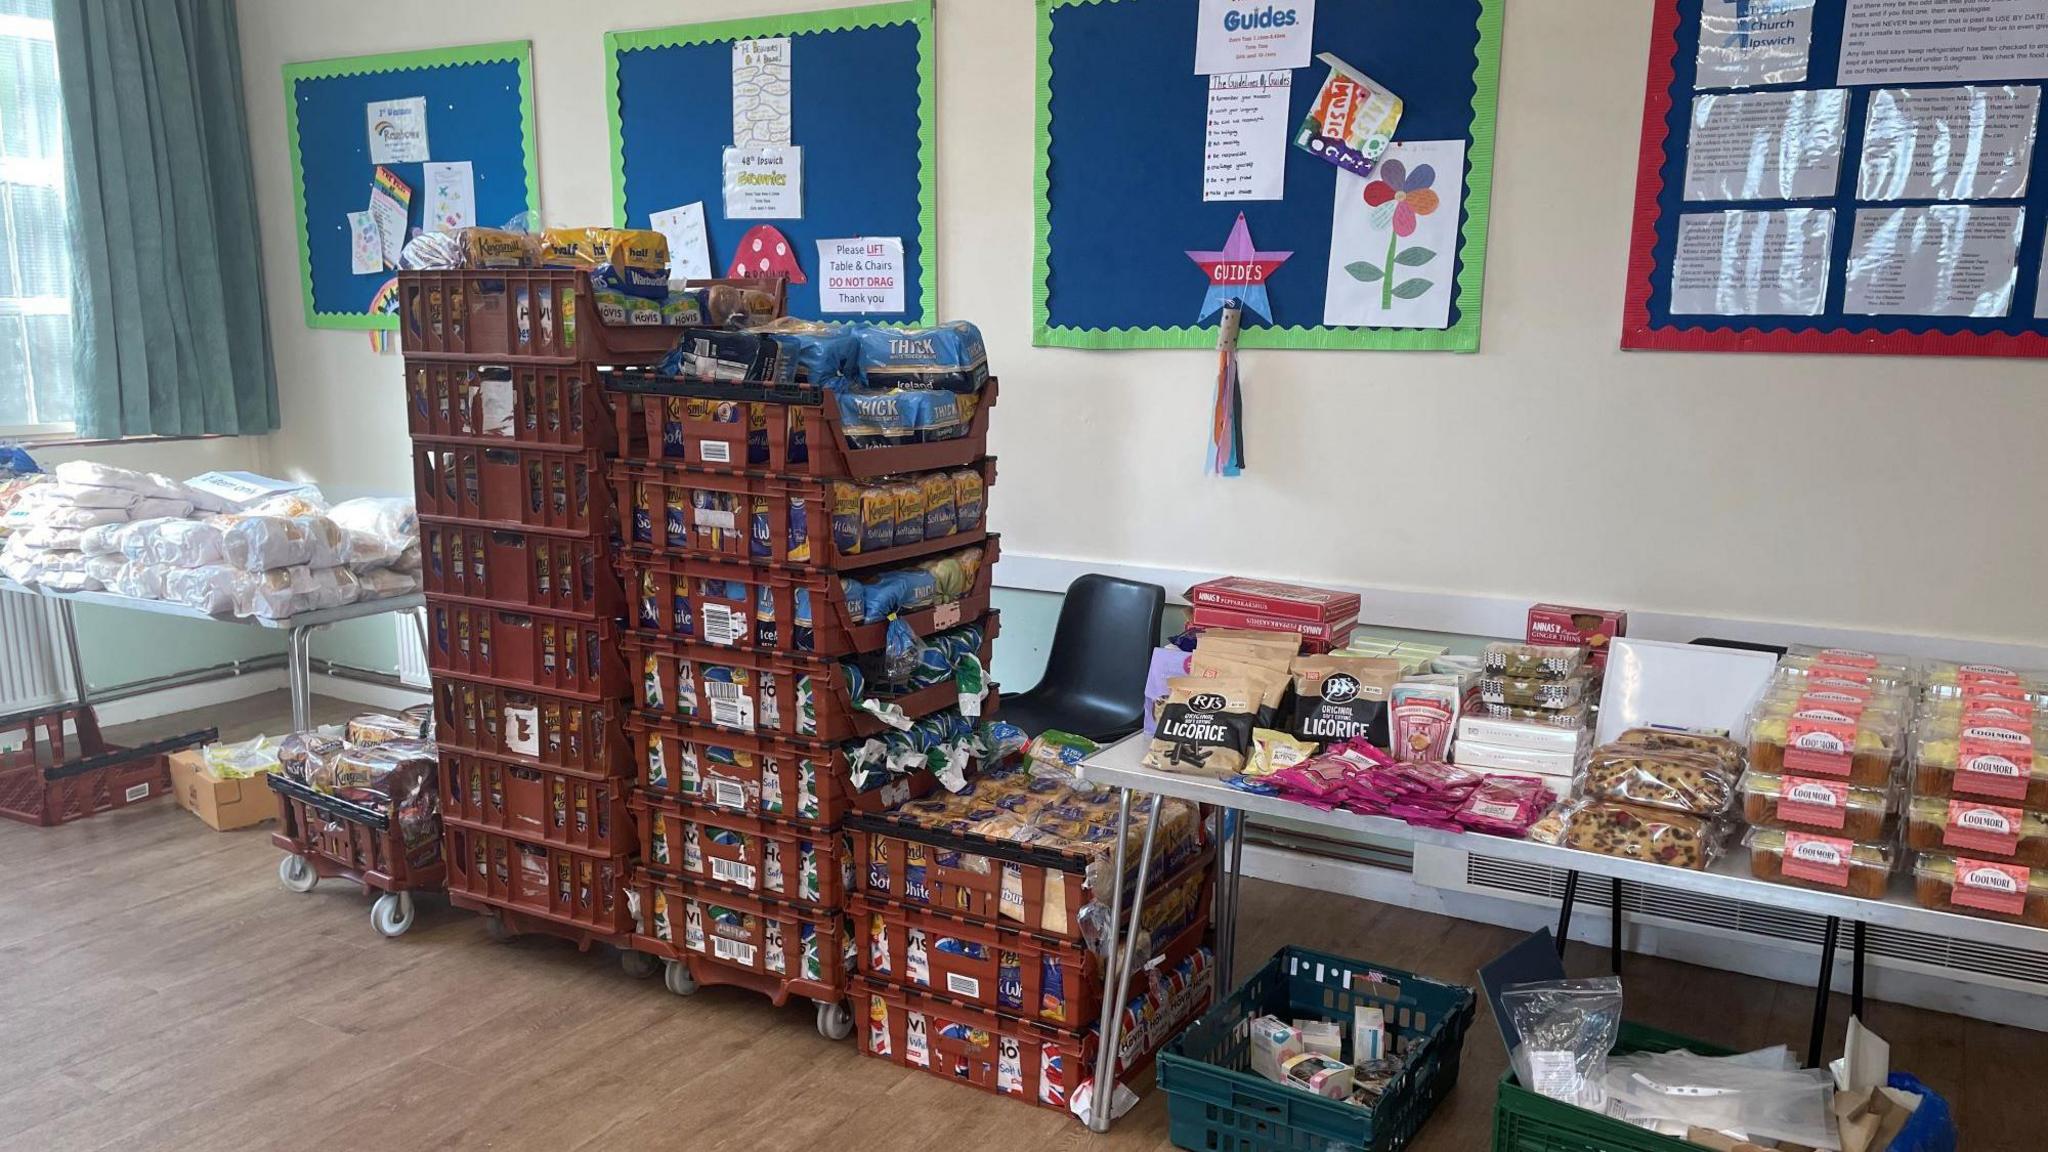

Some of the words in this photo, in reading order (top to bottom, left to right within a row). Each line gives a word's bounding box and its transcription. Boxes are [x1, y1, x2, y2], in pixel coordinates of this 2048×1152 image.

[1224, 5, 1296, 32] Guides
[2025, 13, 2046, 21] DATE
[1751, 20, 1795, 31] Church
[1968, 25, 1987, 33] illegal
[1749, 36, 1795, 50] Ipswich
[1874, 57, 1914, 65] temperature
[1213, 76, 1227, 89] The
[1228, 73, 1259, 88] Guidelines
[1268, 72, 1290, 87] Guides
[1328, 83, 1351, 138] MUSIC
[757, 155, 784, 166] Ipswich
[478, 237, 521, 257] Kingsmill
[629, 248, 648, 257] half
[837, 244, 865, 255] Please
[866, 244, 885, 255] LIFT
[830, 261, 854, 271] Table
[855, 260, 863, 271] &
[864, 260, 893, 271] Chairs
[1214, 264, 1263, 282] GUIDES
[829, 277, 843, 287] DO
[845, 277, 865, 287] NOT
[867, 276, 894, 287] DRAG
[838, 293, 866, 303] Thank
[867, 295, 885, 305] you
[888, 339, 936, 354] THICK
[897, 381, 934, 389] Iceland
[855, 399, 899, 416] THICK
[927, 513, 939, 524] Soft
[1198, 592, 1216, 602] ANNAS
[1302, 624, 1323, 636] ANNAS
[1532, 621, 1555, 632] ANNAS
[1531, 631, 1559, 641] GINGER
[1559, 633, 1581, 643] THINS
[1321, 705, 1353, 716] ORIGINAL
[1184, 713, 1215, 721] ORIGINAL
[1163, 719, 1228, 742] LICORICE
[1303, 717, 1370, 740] LICORICE
[1970, 728, 2022, 741] COOLMORE
[1972, 760, 2013, 775] COOLMORE
[1793, 788, 1831, 803] COOLMORE
[1964, 813, 2004, 829] COOLMORE
[1797, 845, 1836, 860] COOLMORE
[1970, 872, 2011, 889] COOLMORE
